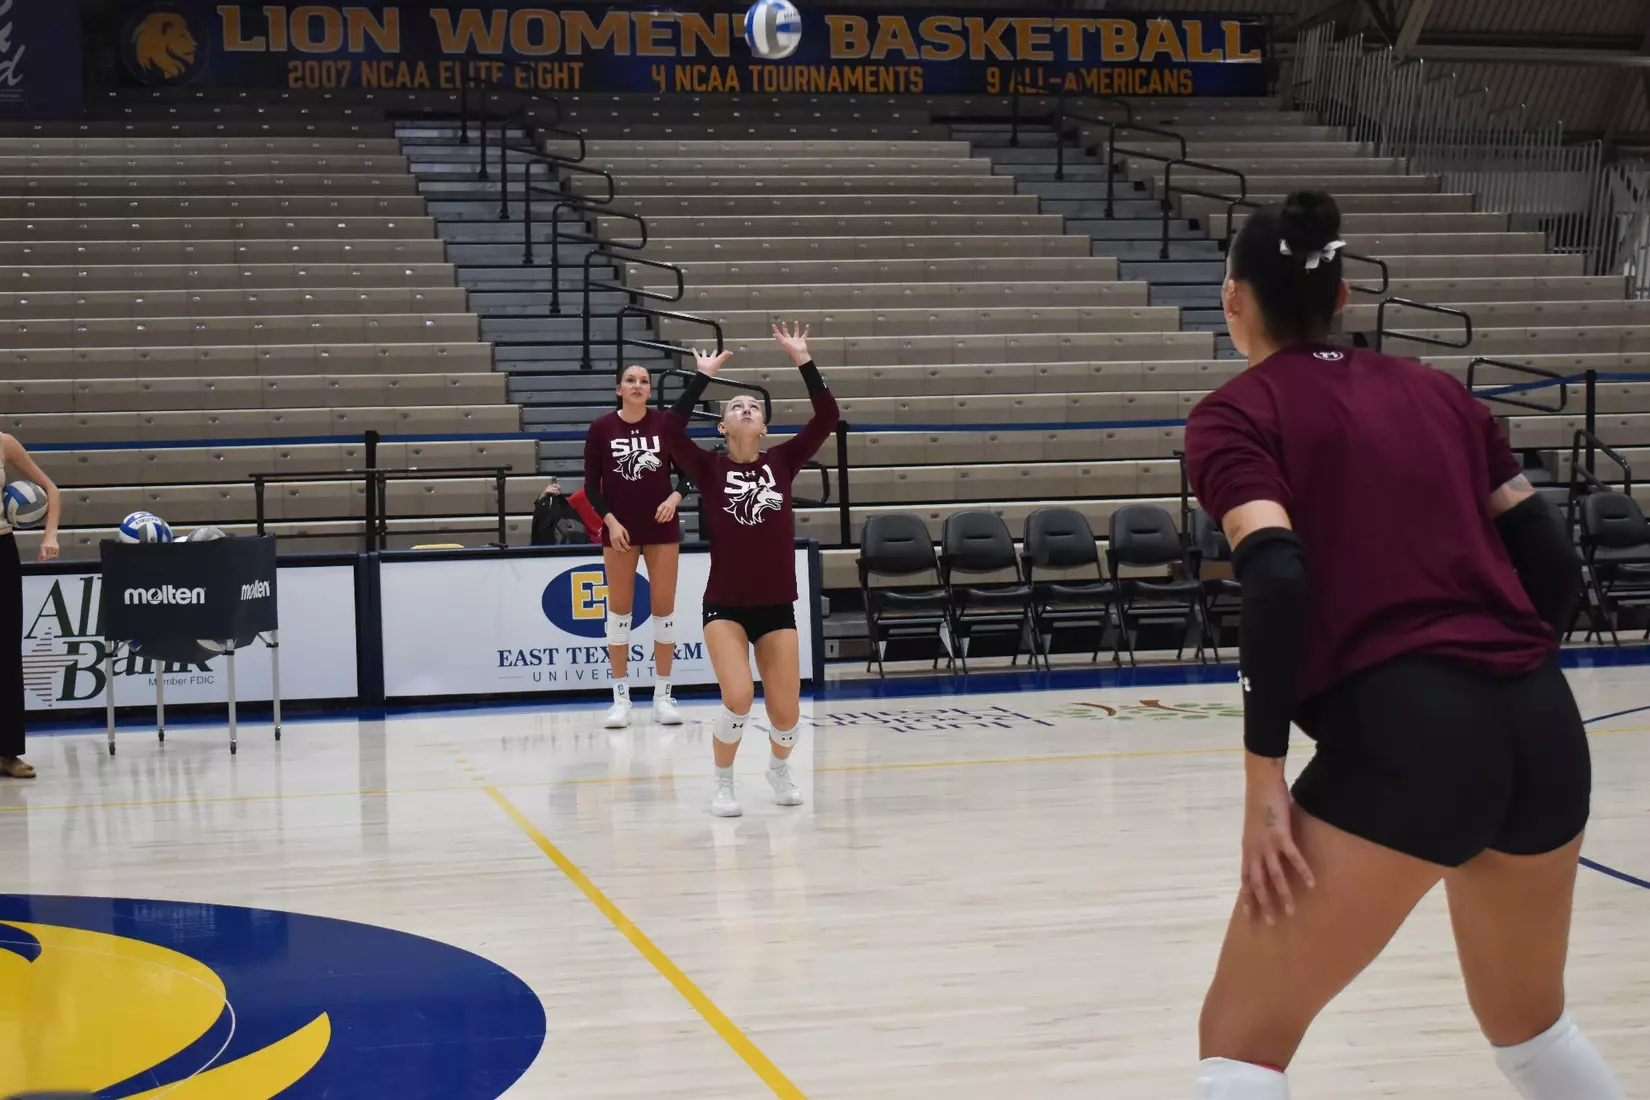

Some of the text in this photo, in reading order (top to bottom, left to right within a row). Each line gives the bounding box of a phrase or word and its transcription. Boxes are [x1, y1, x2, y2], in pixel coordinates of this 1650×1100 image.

[216, 5, 1262, 64] LION WOMEN' BASKETBALL
[288, 60, 584, 90] 2007 NCAA ELITE EIGHT
[651, 63, 924, 93] 4 NCAA TOURNAMENTS
[986, 66, 1193, 95] 9 ALL-AMERICANS
[610, 435, 661, 457] SIU
[124, 585, 206, 605] molten
[240, 580, 271, 601] molten
[23, 576, 105, 639] All
[497, 642, 704, 668] EAST TEXS &M
[148, 675, 215, 687] Mmber FDIC
[532, 666, 655, 683] UNIVERIT
